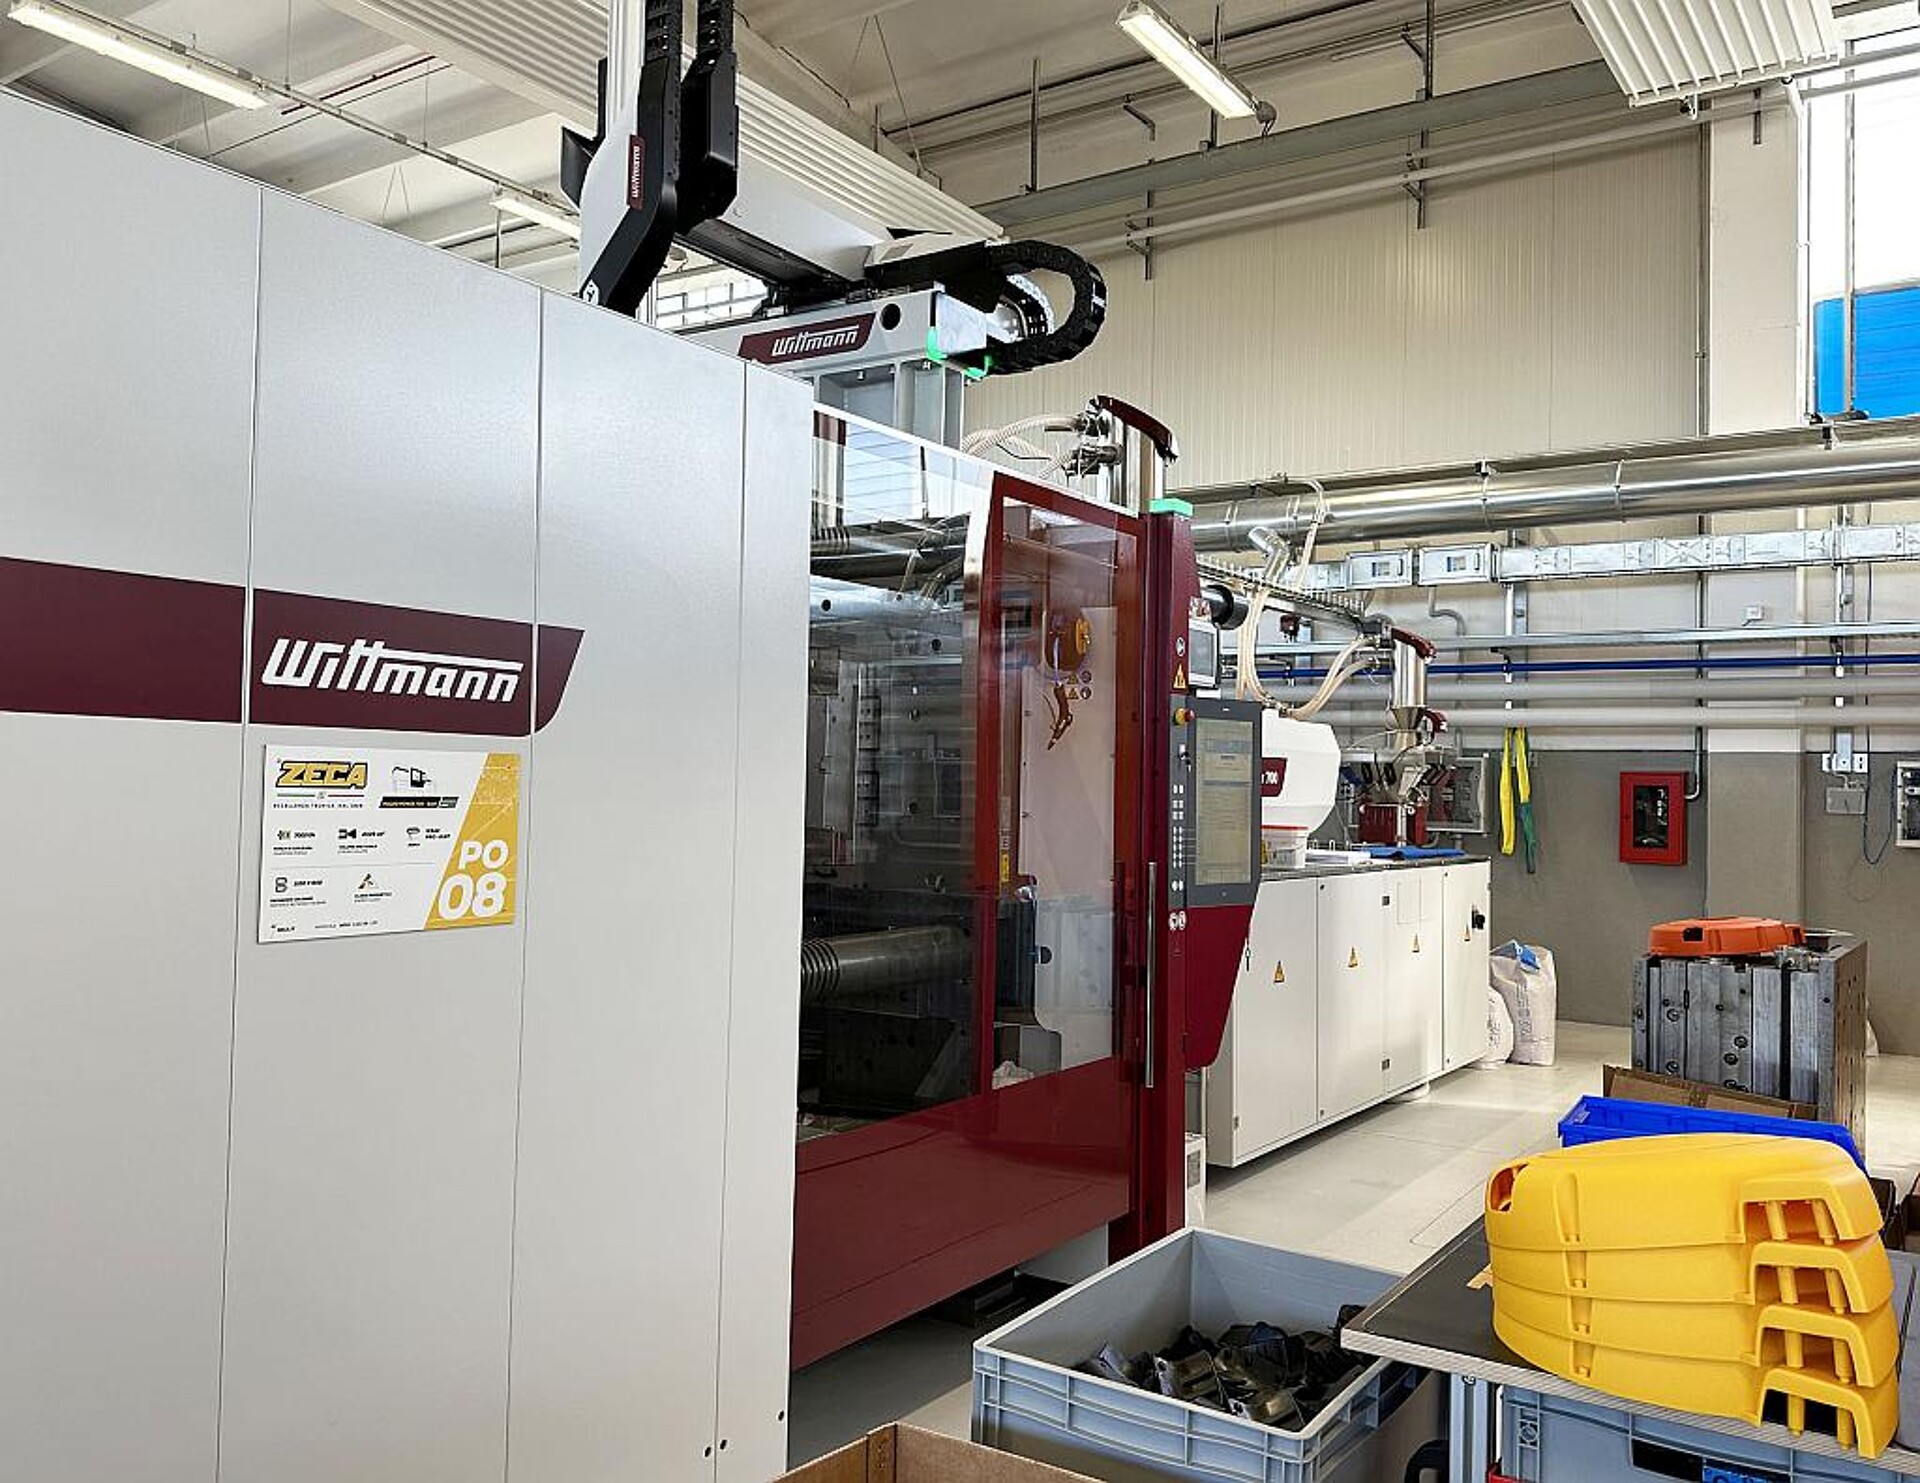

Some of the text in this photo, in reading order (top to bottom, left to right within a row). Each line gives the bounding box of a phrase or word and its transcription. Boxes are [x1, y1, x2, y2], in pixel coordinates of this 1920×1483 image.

[771, 325, 860, 357] Wittmann
[261, 637, 524, 703] Wittmann
[276, 761, 368, 789] ZECA
[457, 839, 509, 871] PO
[438, 871, 507, 921] 08
